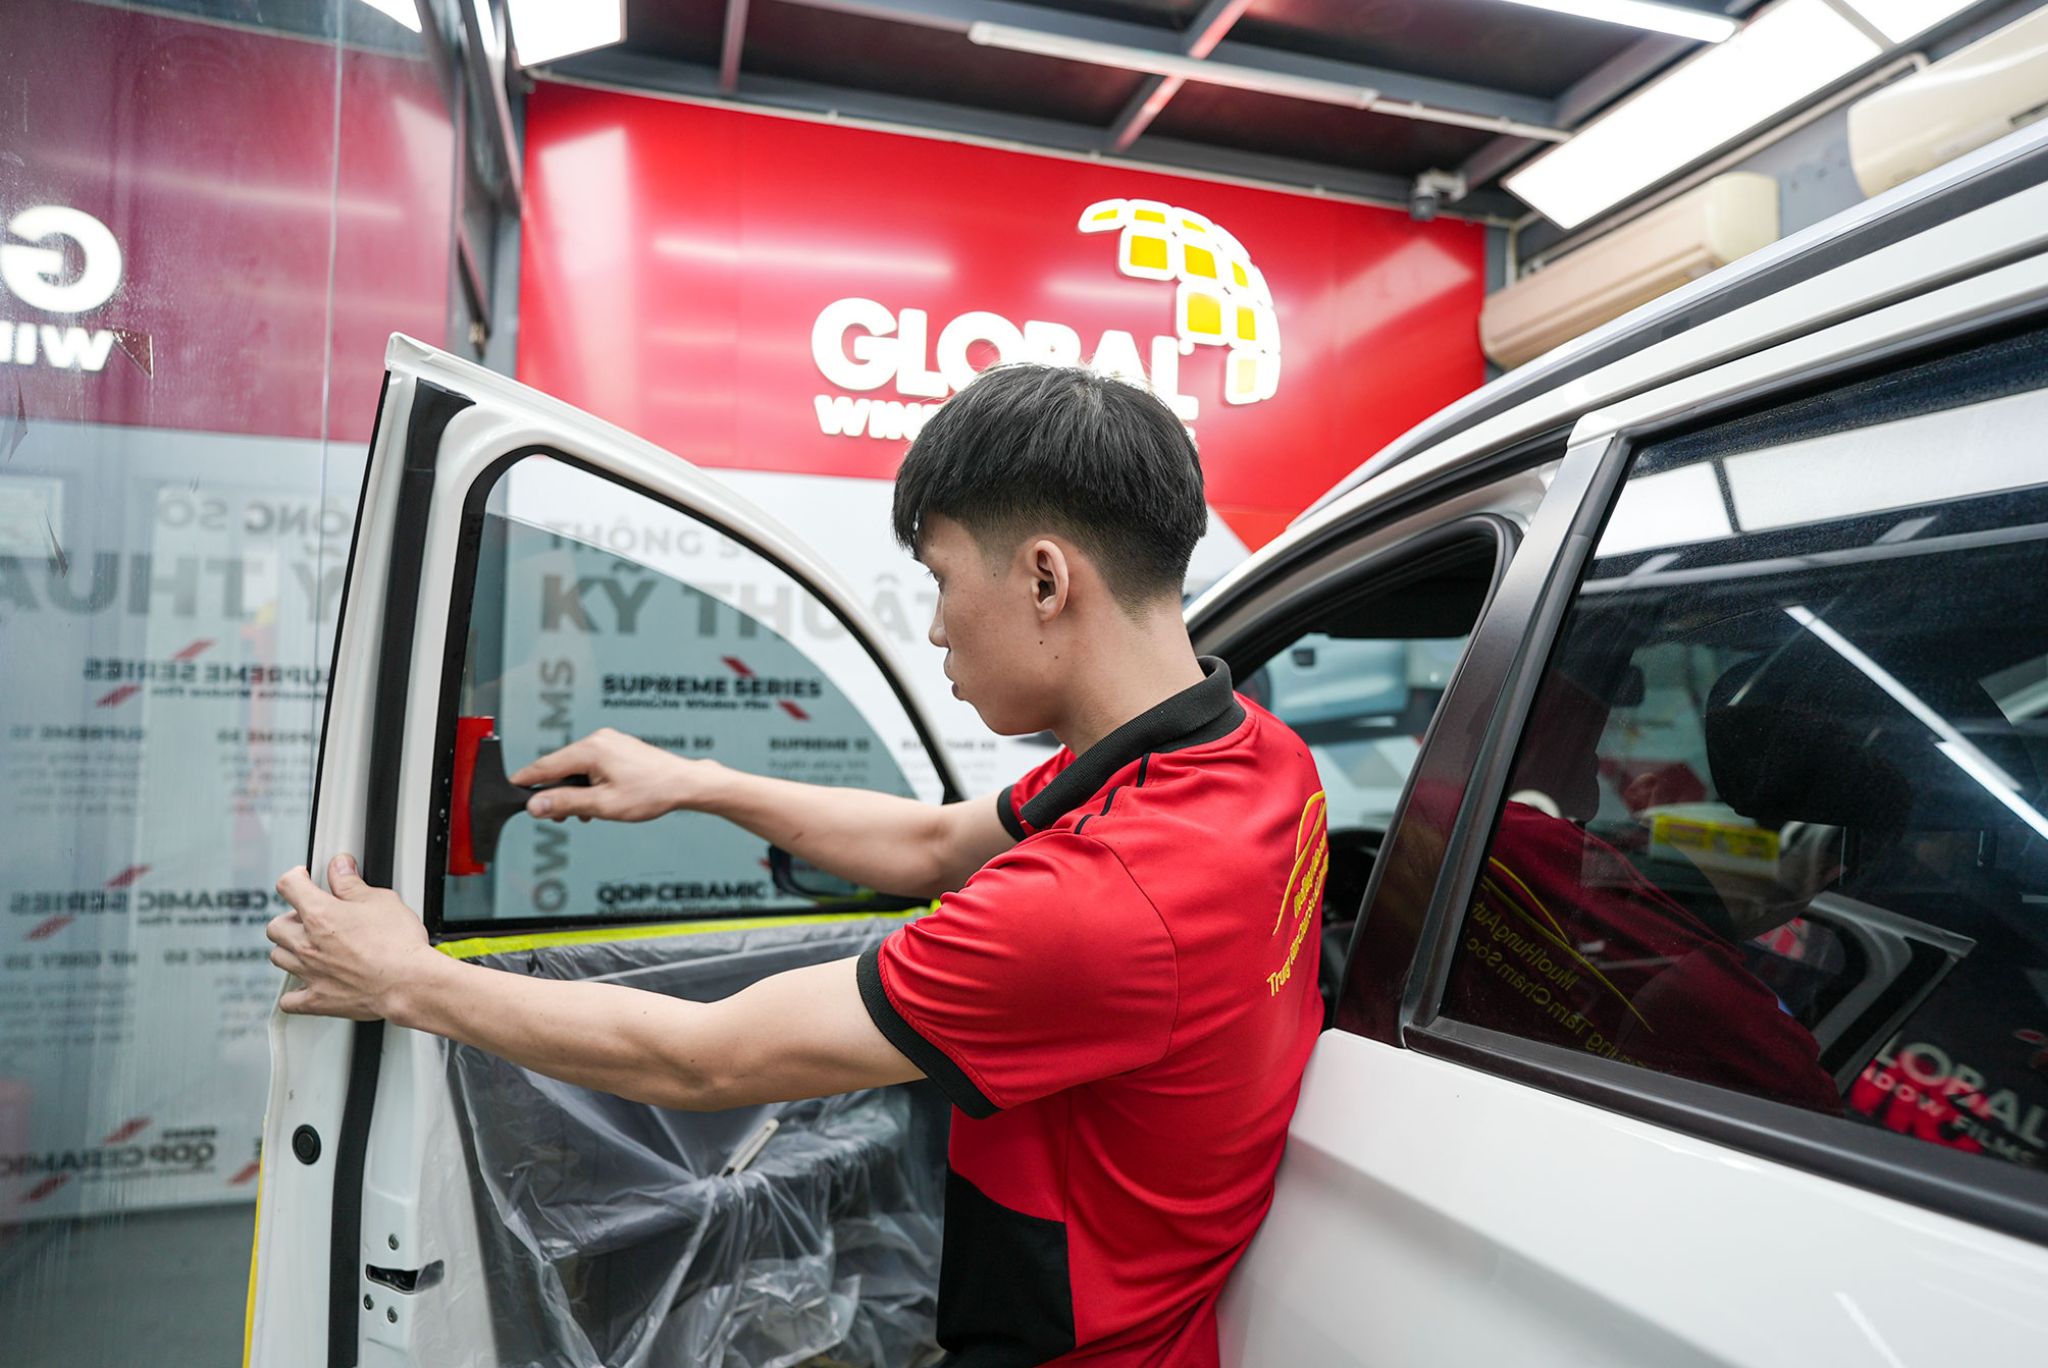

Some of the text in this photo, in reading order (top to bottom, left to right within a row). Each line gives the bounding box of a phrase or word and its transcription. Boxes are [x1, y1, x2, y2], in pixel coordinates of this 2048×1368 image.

[813, 394, 940, 441] WIN
[718, 528, 747, 561] S
[540, 560, 659, 636] KỸ
[602, 674, 822, 698] SUPREME SERIES
[656, 880, 768, 900] CERAMIC
